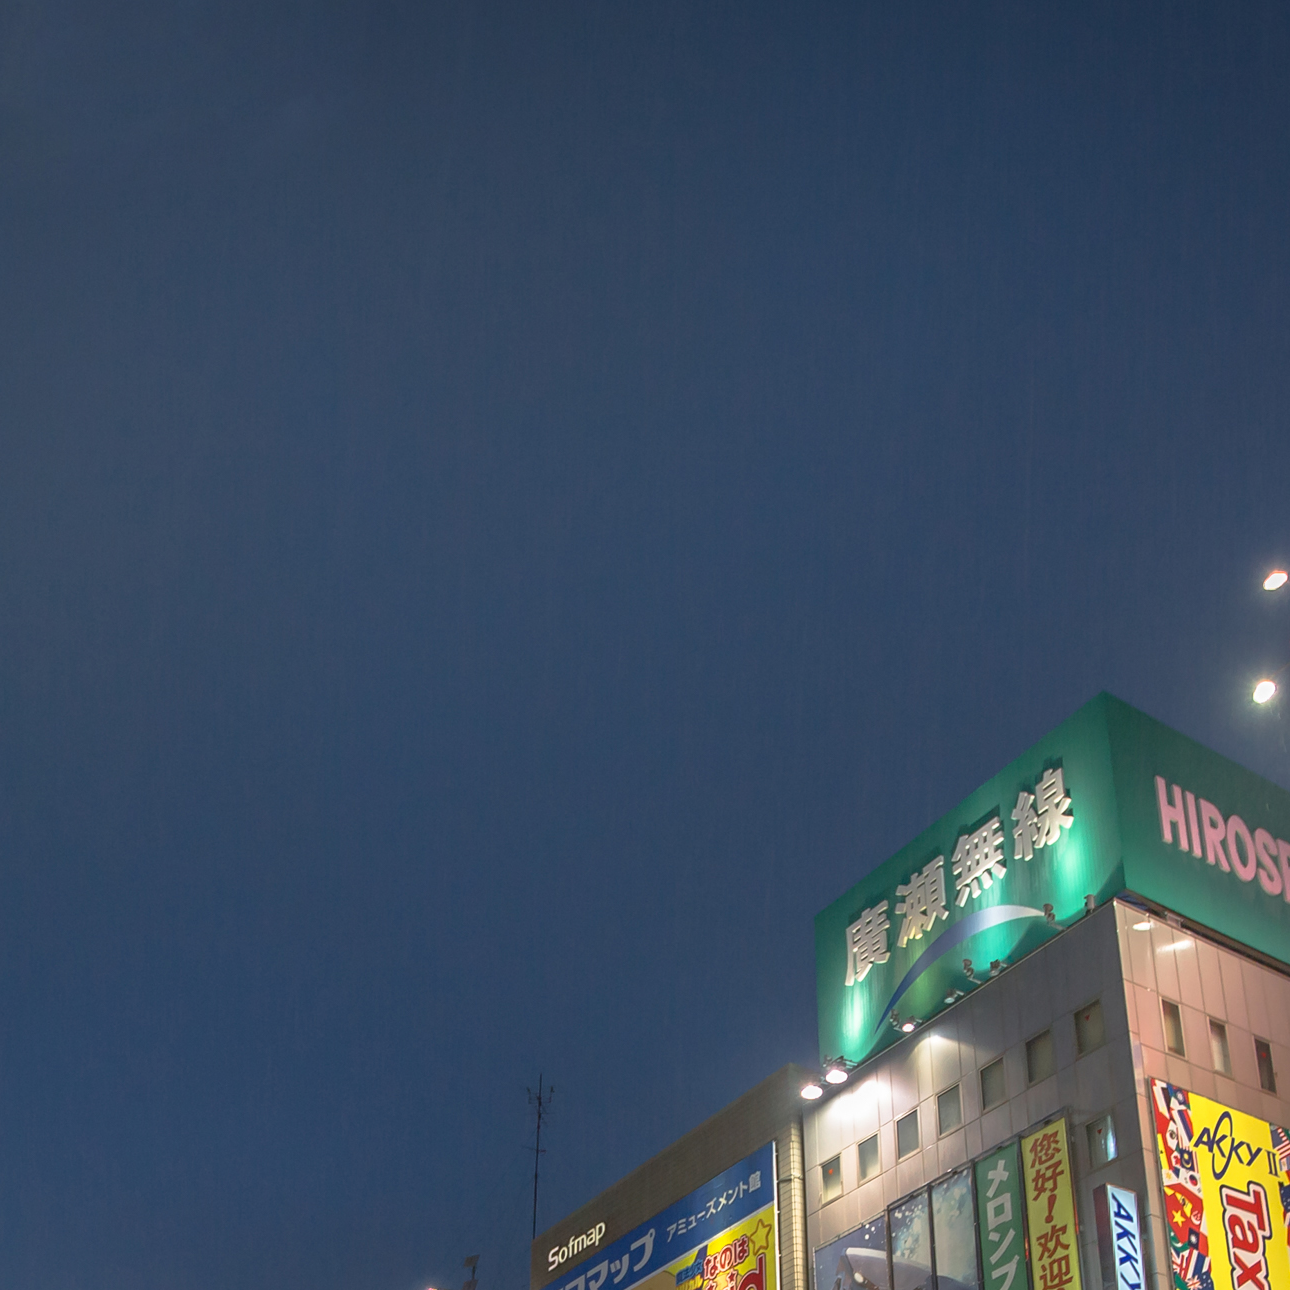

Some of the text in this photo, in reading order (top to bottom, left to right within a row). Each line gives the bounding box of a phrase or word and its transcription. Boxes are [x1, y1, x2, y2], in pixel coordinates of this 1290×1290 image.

[845, 766, 1076, 987] 廣瀬無線
[666, 1170, 762, 1244] アミューズメント館
[547, 1220, 607, 1272] Sofmap
[703, 1234, 749, 1281] なのは
